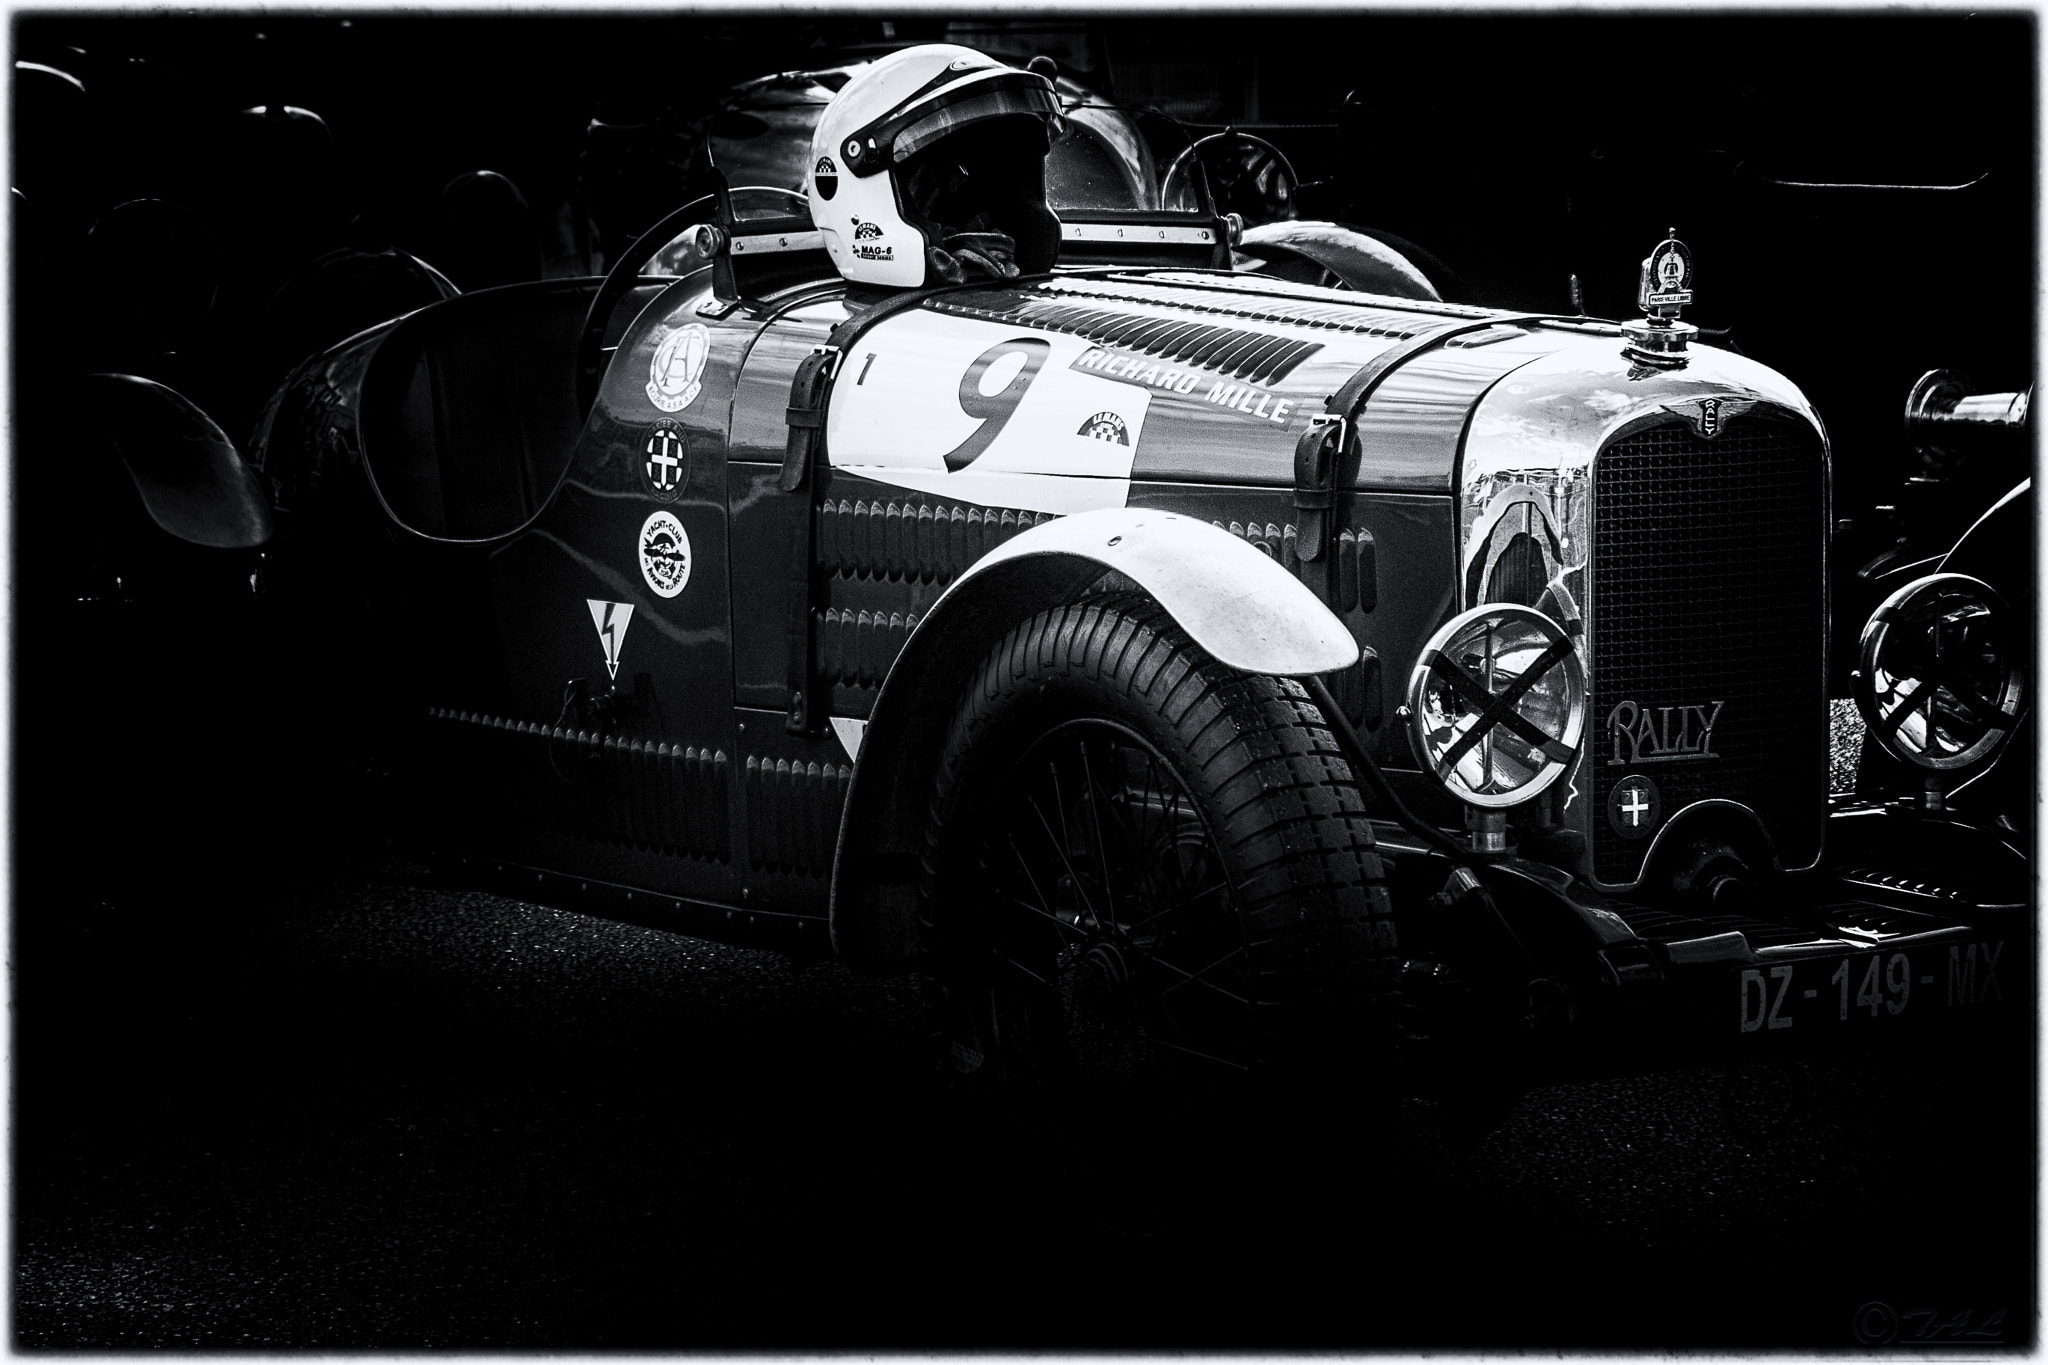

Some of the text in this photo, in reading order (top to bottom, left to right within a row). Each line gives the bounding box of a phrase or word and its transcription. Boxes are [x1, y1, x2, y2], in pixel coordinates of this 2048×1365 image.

[861, 245, 892, 255] MAG-6
[857, 353, 877, 386] 1
[1077, 350, 1294, 424] RICHARD MILLE
[943, 337, 1051, 474] 9
[1705, 399, 1715, 435] RALLY
[672, 563, 686, 587] ROUTE
[1606, 699, 1726, 766] RALLY
